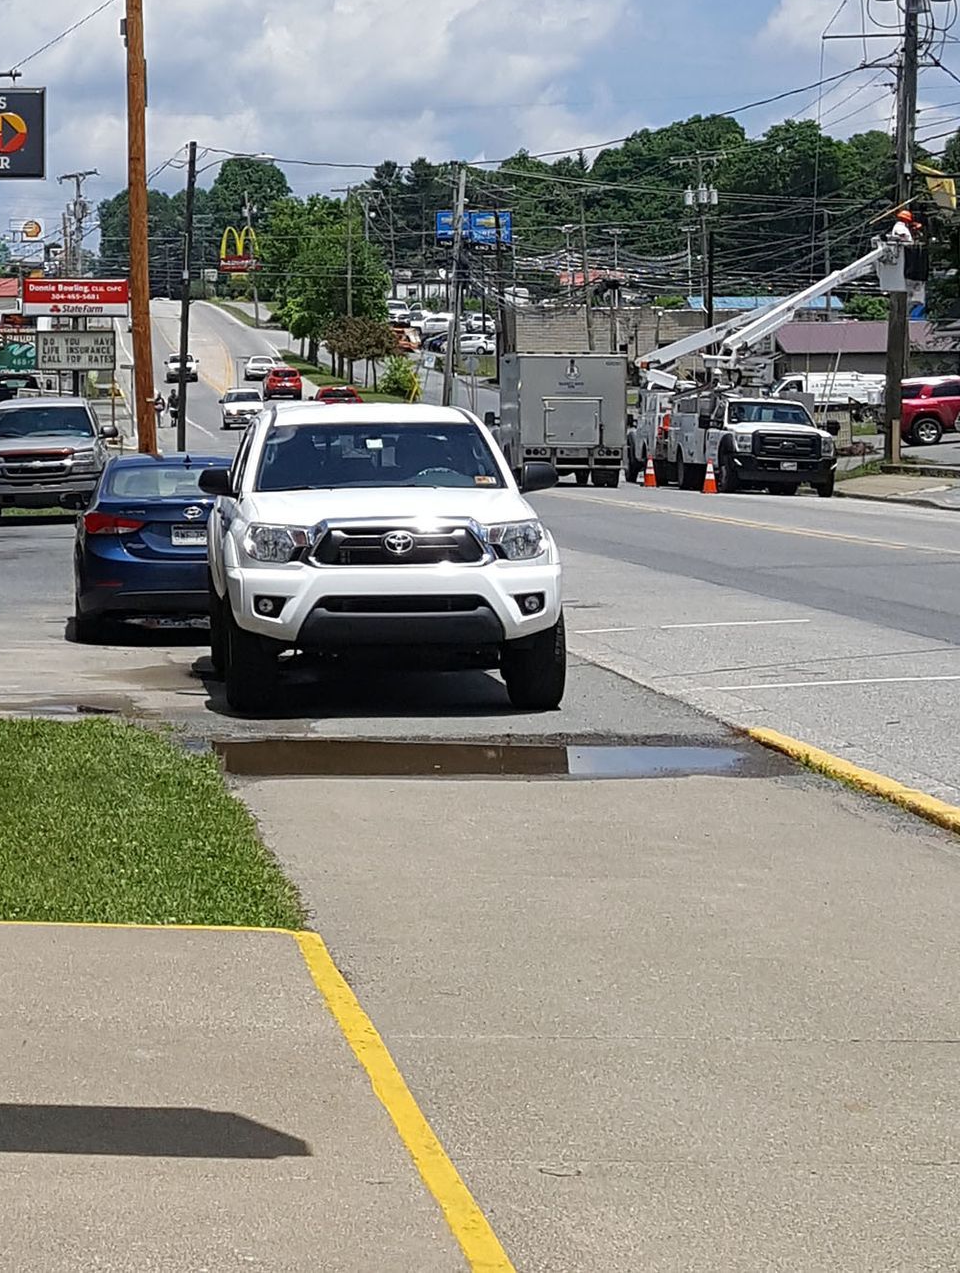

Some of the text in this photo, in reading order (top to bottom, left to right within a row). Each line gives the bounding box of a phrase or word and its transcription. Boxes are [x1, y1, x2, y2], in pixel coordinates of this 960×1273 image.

[43, 338, 55, 346] DO
[64, 337, 80, 346] YOU
[41, 355, 61, 363] CALL
[88, 355, 114, 363] RATES
